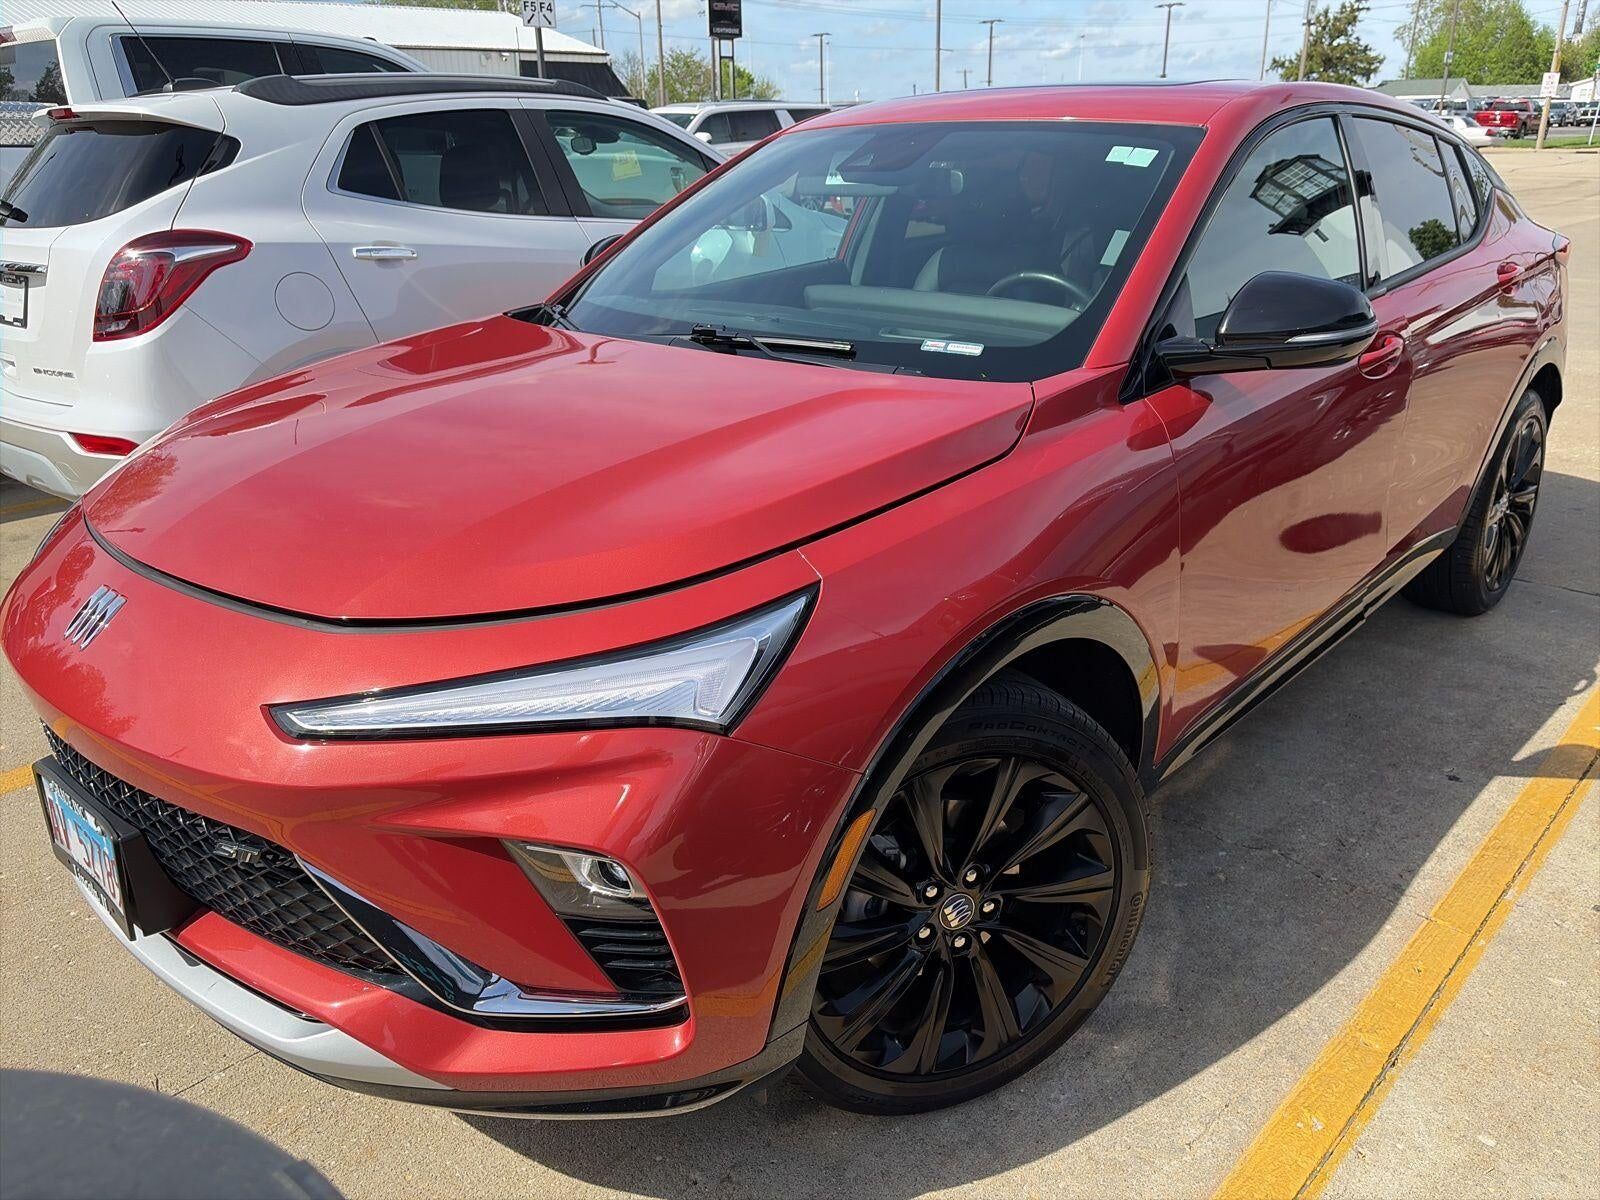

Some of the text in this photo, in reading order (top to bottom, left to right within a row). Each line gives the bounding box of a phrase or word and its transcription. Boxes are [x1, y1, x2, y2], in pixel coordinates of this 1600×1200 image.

[523, 1, 537, 12] F5
[539, 2, 553, 13] F4
[712, 2, 739, 11] GMC
